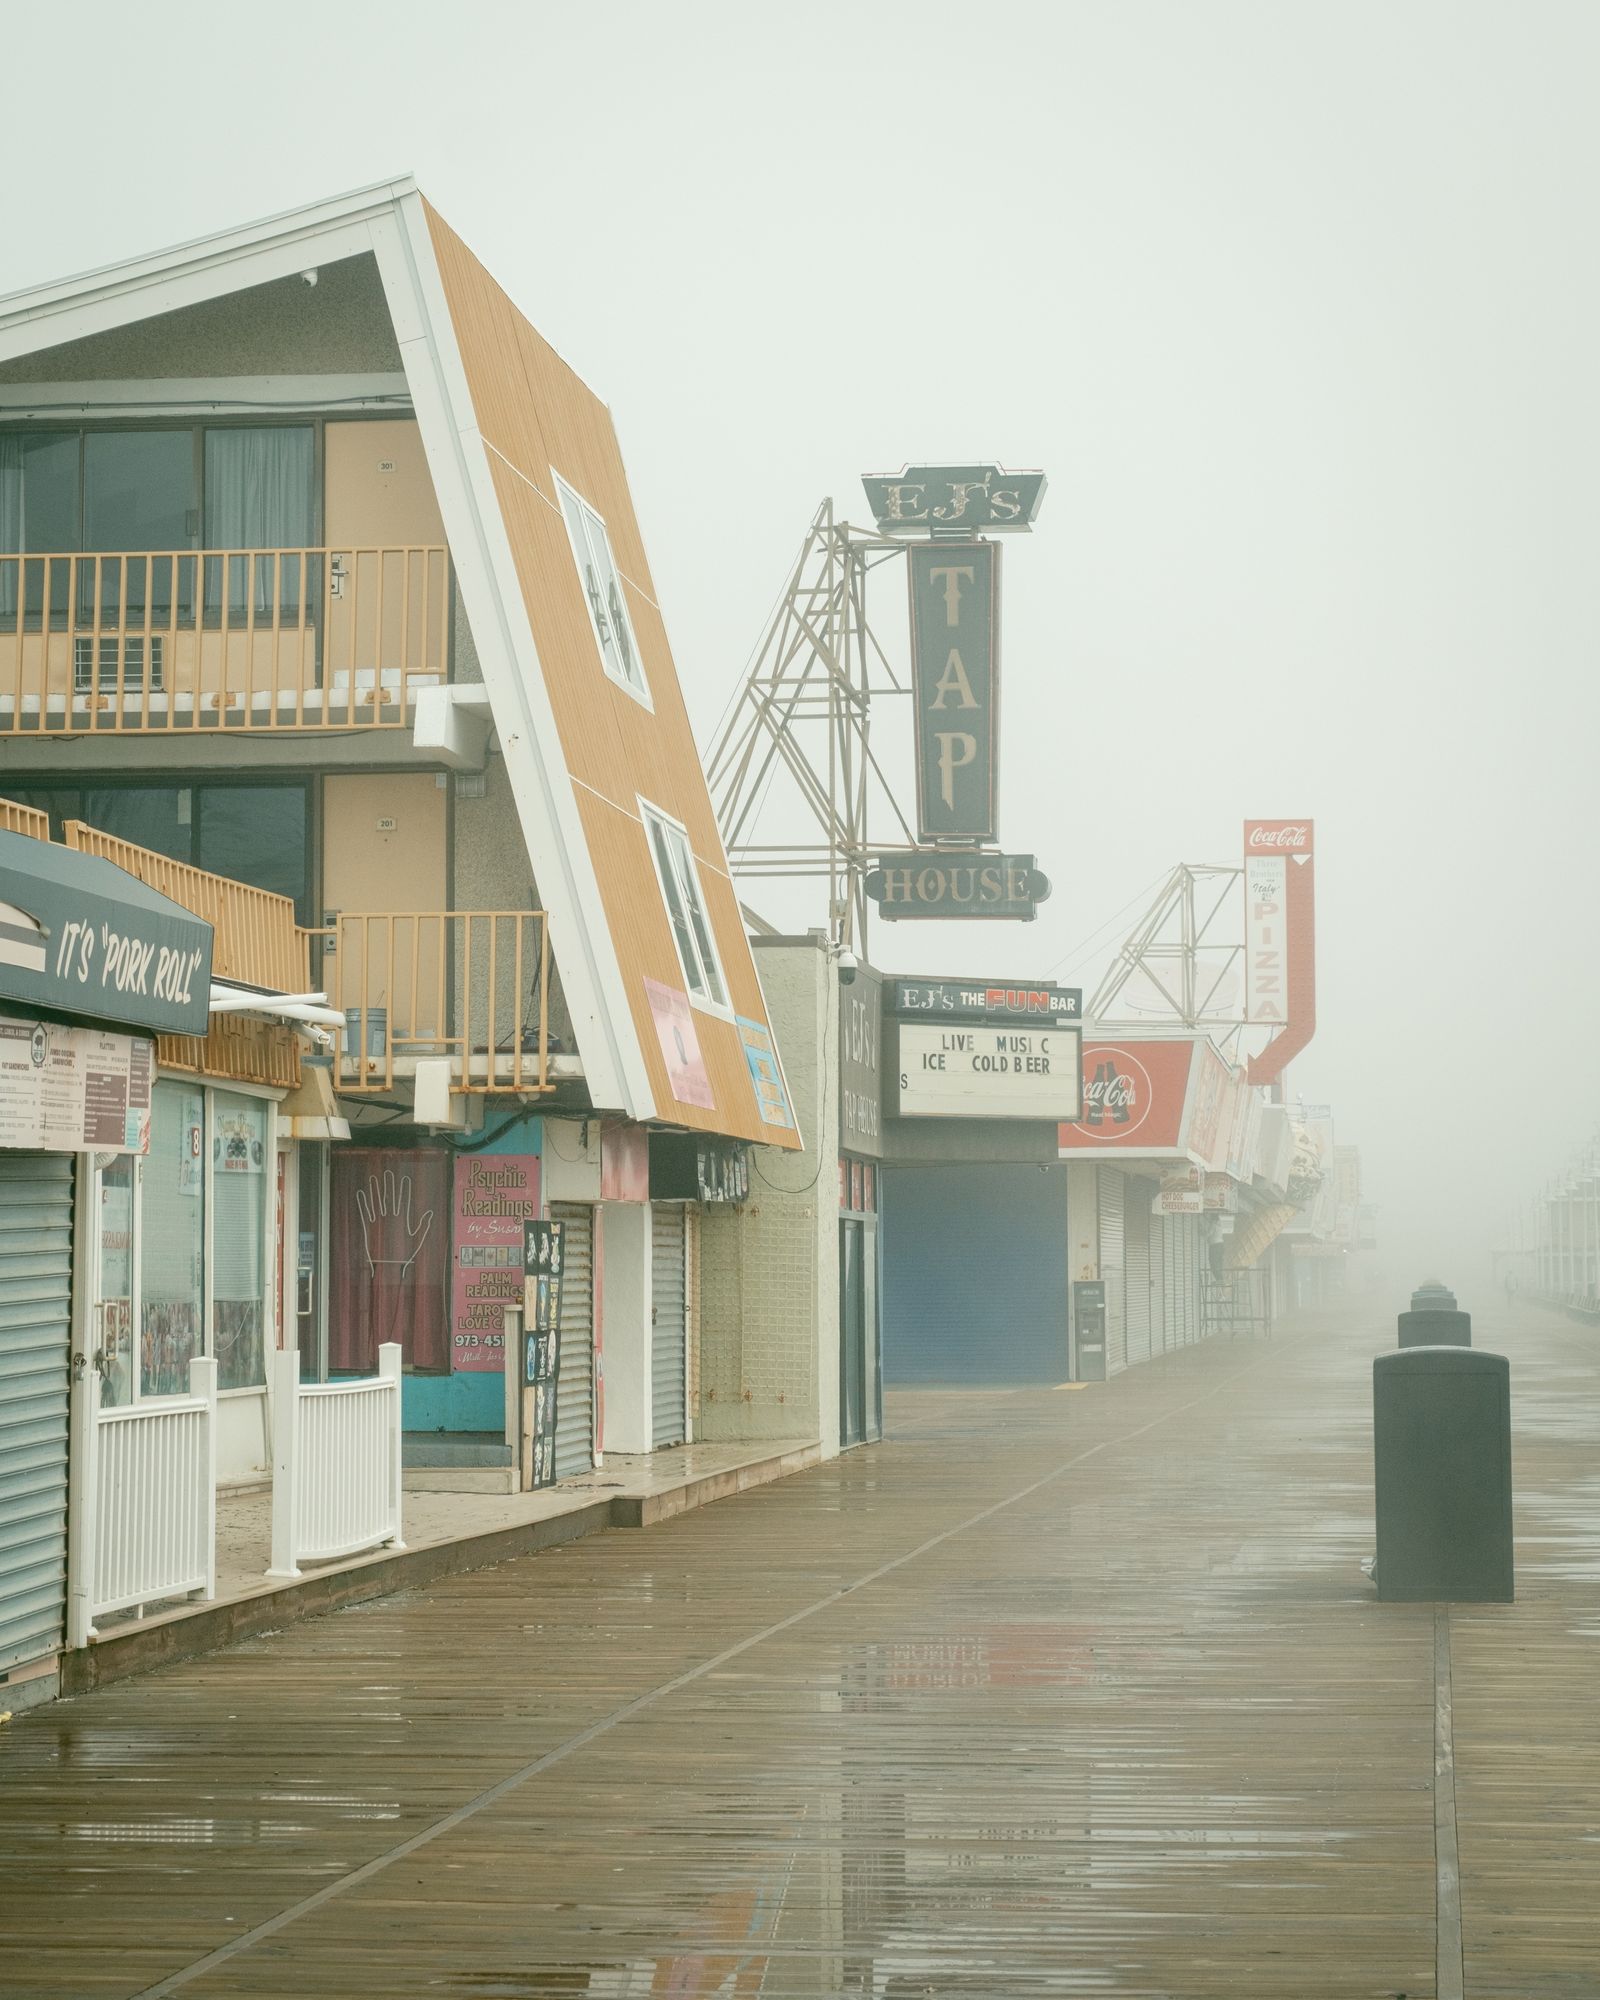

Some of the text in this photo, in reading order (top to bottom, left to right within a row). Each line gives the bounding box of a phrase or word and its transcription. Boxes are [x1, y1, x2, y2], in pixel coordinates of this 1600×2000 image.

[380, 462, 393, 470] 301
[881, 471, 1021, 520] EJ's
[928, 566, 981, 812] TAP
[1249, 826, 1308, 847] Coca-Cola
[884, 868, 1029, 903] HOUSE
[1252, 883, 1276, 895] Italy
[57, 918, 202, 1005] IT'S "PORK ROLL"
[1253, 903, 1281, 1018] PIZZA
[902, 984, 1076, 1014] EJ's THE FUN BAR
[942, 1034, 974, 1051] LIVE
[923, 1053, 946, 1070] ICE
[972, 1055, 1008, 1072] COLD
[900, 1073, 908, 1089] S
[468, 1160, 527, 1195] Psychic
[462, 1188, 533, 1226] Readings
[466, 1221, 481, 1239] by
[480, 1272, 512, 1284] PALM
[466, 1285, 524, 1298] READINGS
[459, 1317, 489, 1329] LOVE
[455, 1334, 505, 1347] 973-451
